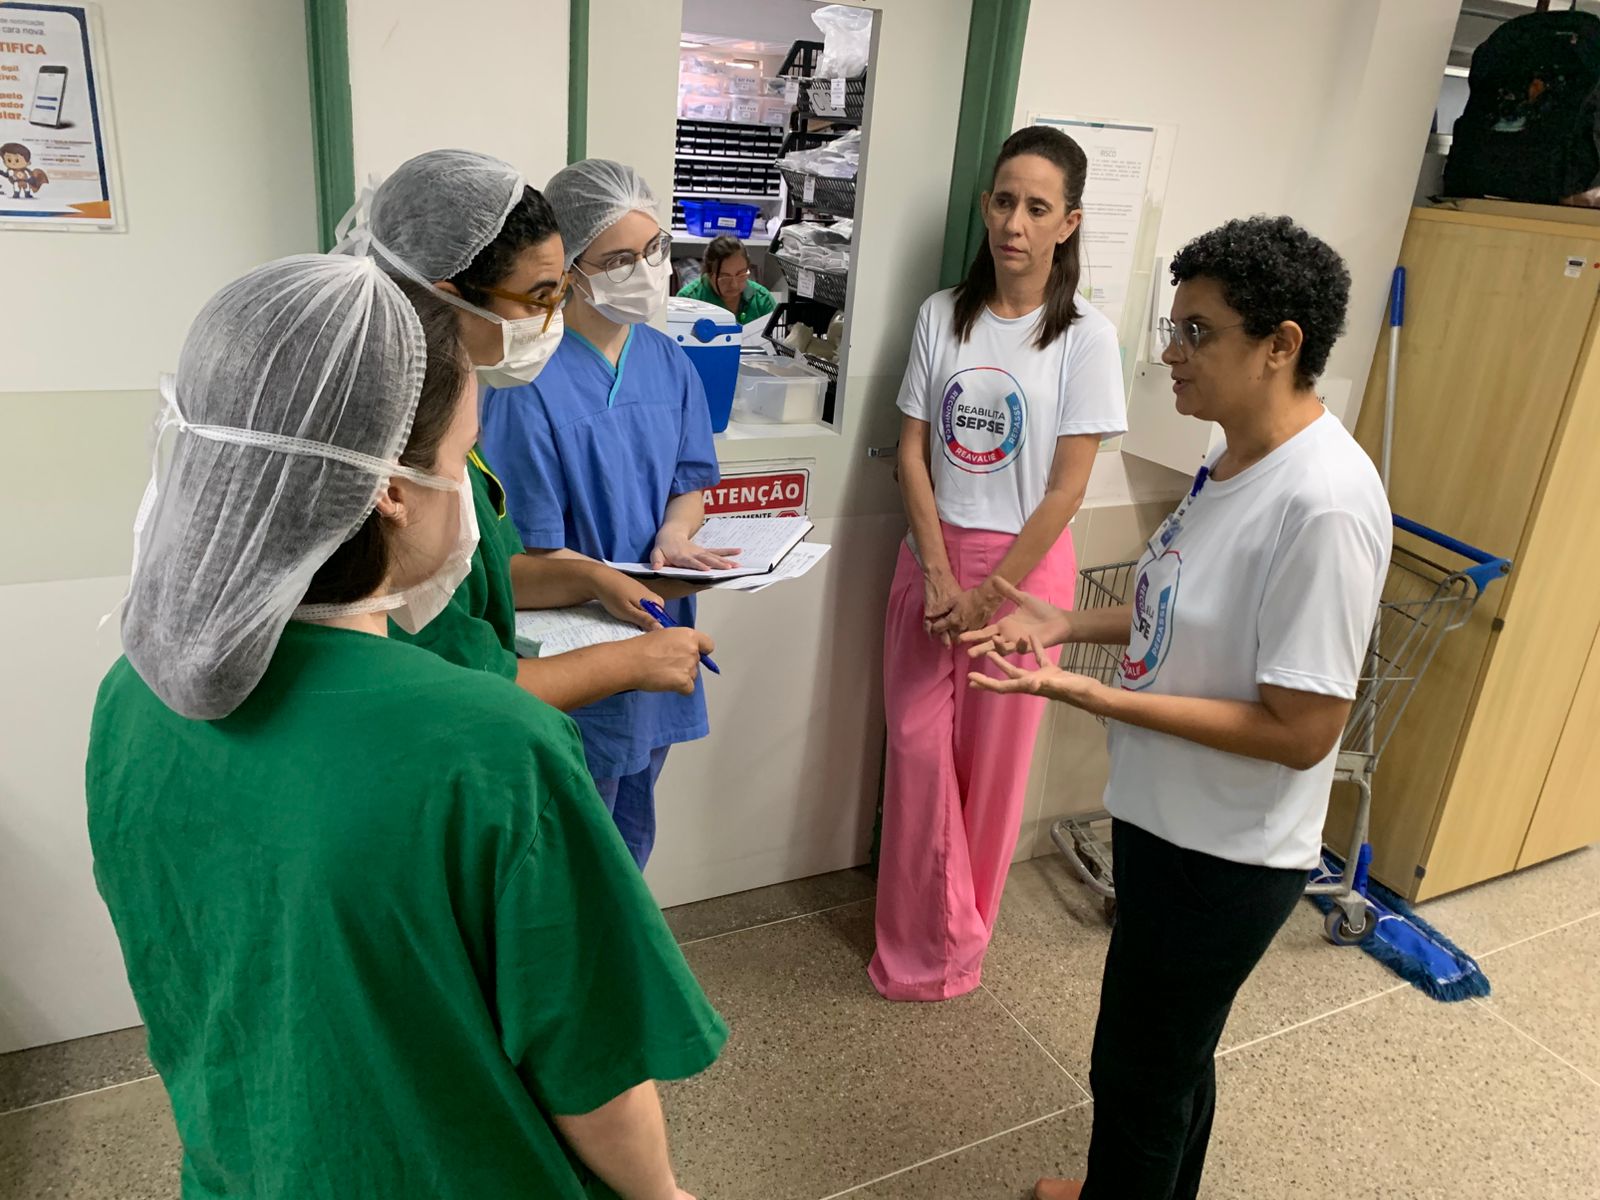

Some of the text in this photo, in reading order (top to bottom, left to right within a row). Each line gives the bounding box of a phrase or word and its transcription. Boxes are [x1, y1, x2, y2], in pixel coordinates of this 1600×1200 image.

[22, 27, 47, 35] nova.
[957, 404, 1006, 421] REABILITA
[956, 415, 1005, 435] SEPSE
[1007, 404, 1021, 445] REPASSE
[955, 447, 997, 463] REAVALIE
[703, 480, 800, 507] ATENÇÃO
